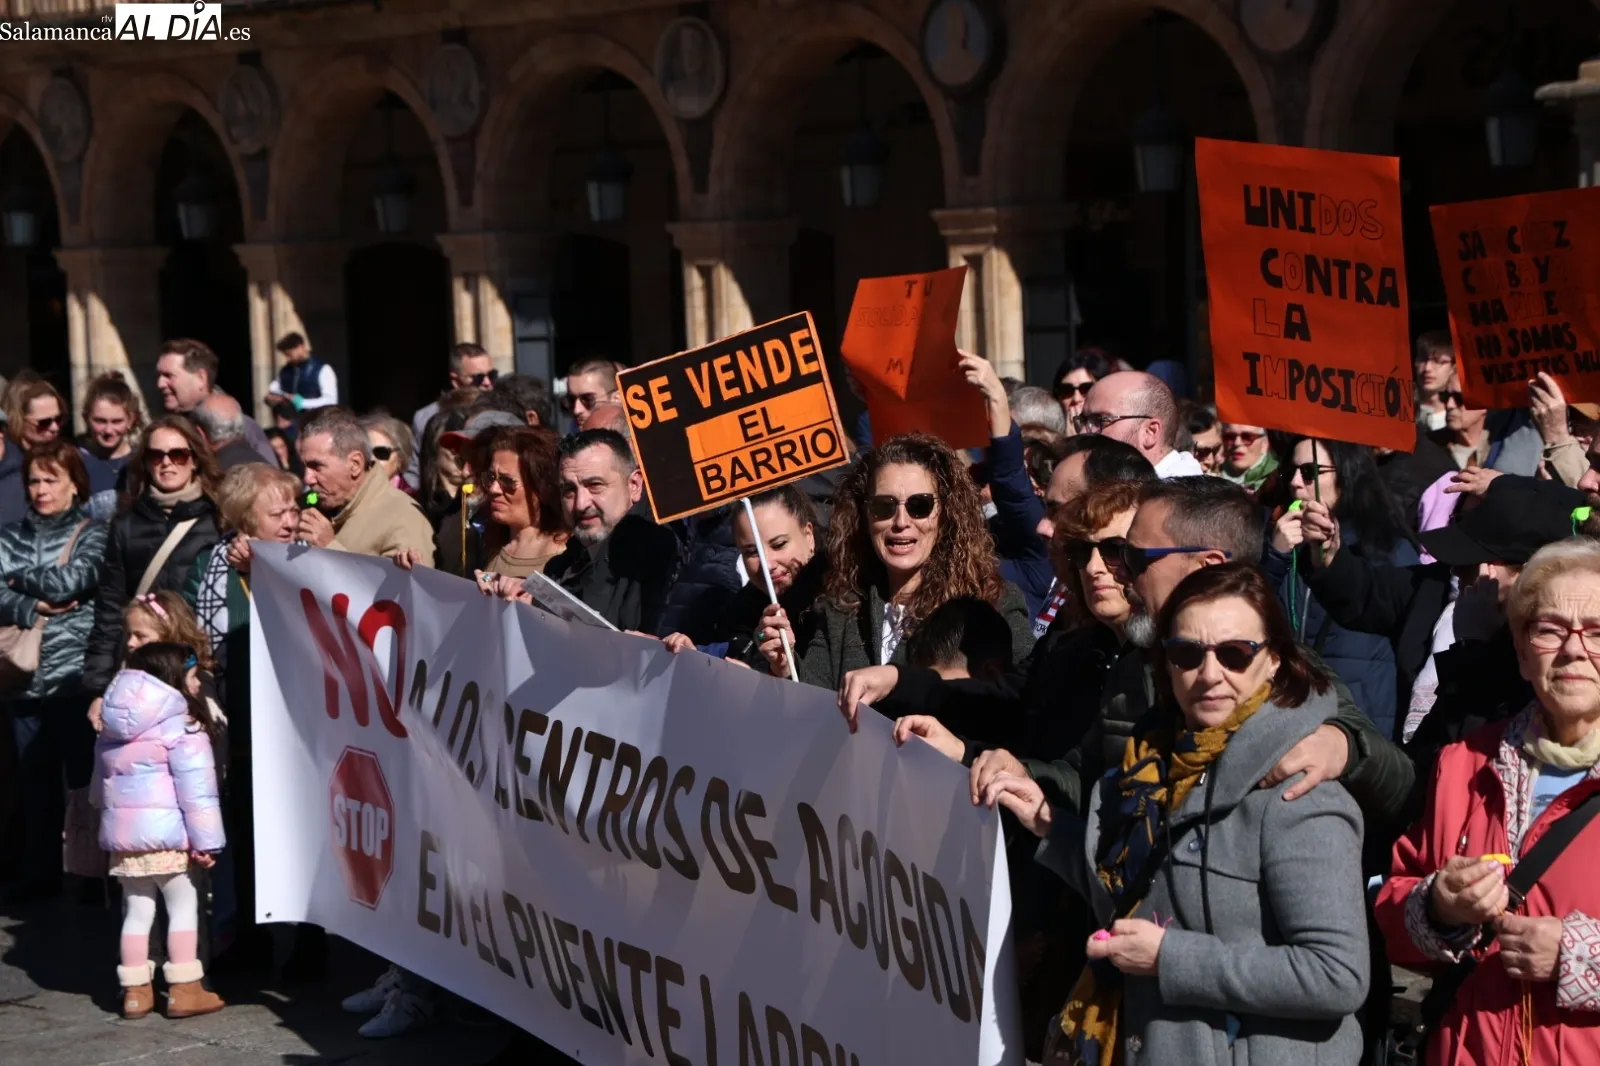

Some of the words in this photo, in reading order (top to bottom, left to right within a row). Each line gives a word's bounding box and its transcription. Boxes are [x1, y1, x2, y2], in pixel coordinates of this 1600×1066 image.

[1243, 184, 1384, 240] UNIDOS
[904, 277, 934, 299] TU
[1260, 248, 1400, 308] CONTRA
[1253, 298, 1312, 342] LA
[1507, 322, 1577, 358] SOMOS
[625, 375, 679, 430] SE
[684, 328, 821, 409] VENDE
[1242, 352, 1416, 423] IMPOSICIÓN
[737, 406, 786, 444] EL
[700, 427, 838, 496] BARRIO
[299, 587, 409, 739] NO
[333, 793, 389, 861] STOP
[700, 776, 798, 914] DE
[417, 829, 468, 947] EN
[469, 888, 516, 980] EL
[502, 890, 693, 1066] PUENTE
